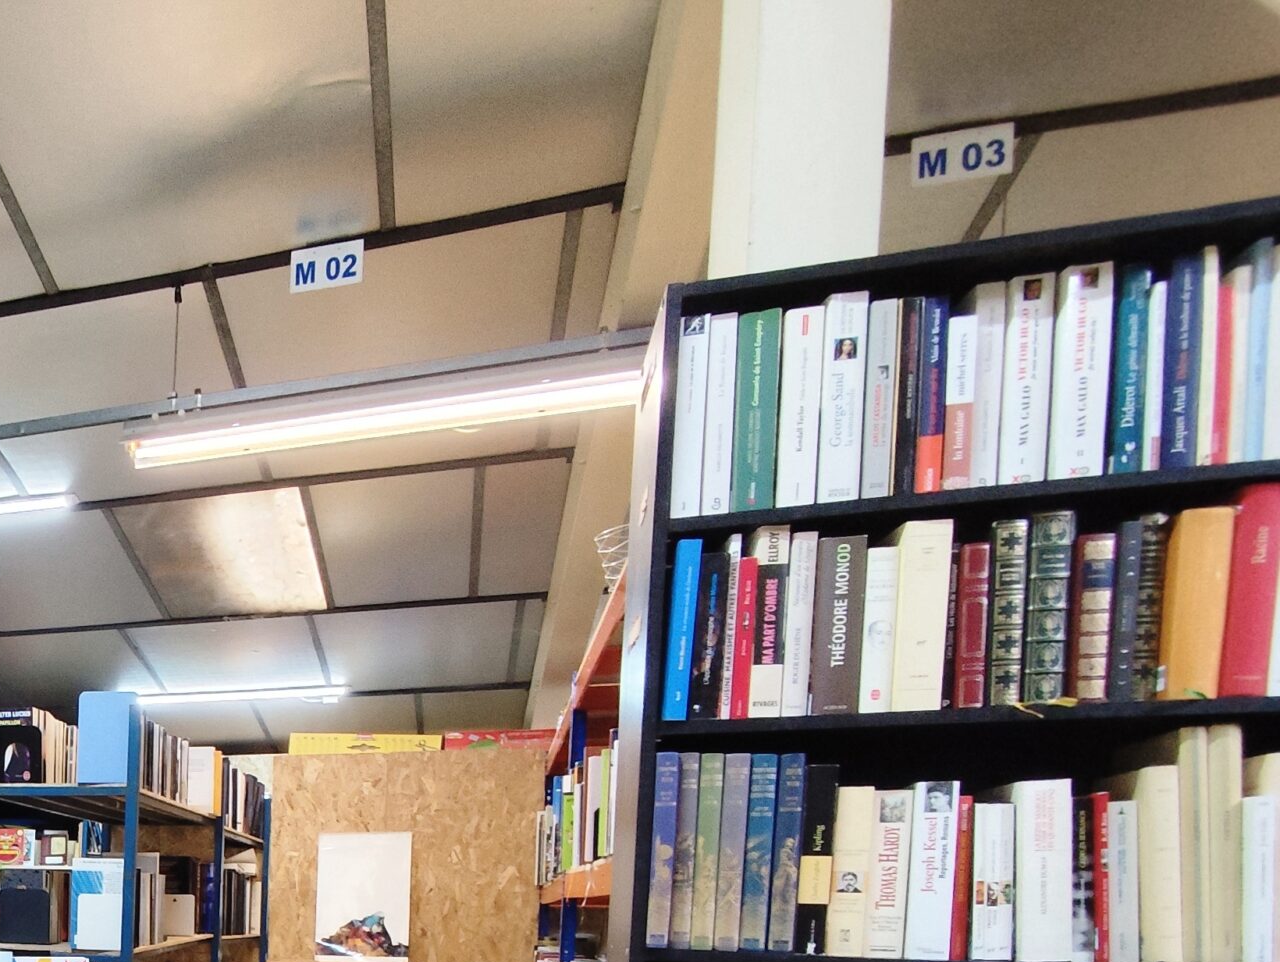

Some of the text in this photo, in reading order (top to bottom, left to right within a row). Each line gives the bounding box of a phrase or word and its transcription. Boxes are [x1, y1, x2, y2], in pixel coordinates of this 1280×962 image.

[919, 138, 1005, 179] M 03
[295, 254, 357, 285] M 02
[1017, 307, 1030, 381] VICTOR HUGO
[1073, 297, 1088, 373] VICTOR HUGO
[955, 333, 968, 396] michel serres
[829, 372, 844, 447] George Sand
[1018, 385, 1031, 446] MAX GALLO
[1076, 377, 1088, 438] MAX GALLO
[1120, 386, 1136, 428] Diderot
[1170, 386, 1188, 453] Jacques Attali
[766, 531, 780, 562] ELLROY
[1251, 525, 1270, 564] Racine
[727, 593, 736, 619] AUTRES
[727, 623, 733, 631] ET
[761, 578, 778, 664] MA PART D'OMBRE
[828, 543, 851, 667] THÉODORE MONOD
[724, 634, 733, 672] MARXISME
[723, 676, 731, 706] CUISINE,
[812, 824, 826, 851] Kipling
[940, 816, 950, 841] Romans
[875, 825, 901, 910] THOMAS HARDY
[919, 816, 939, 894] Joseph Kessel
